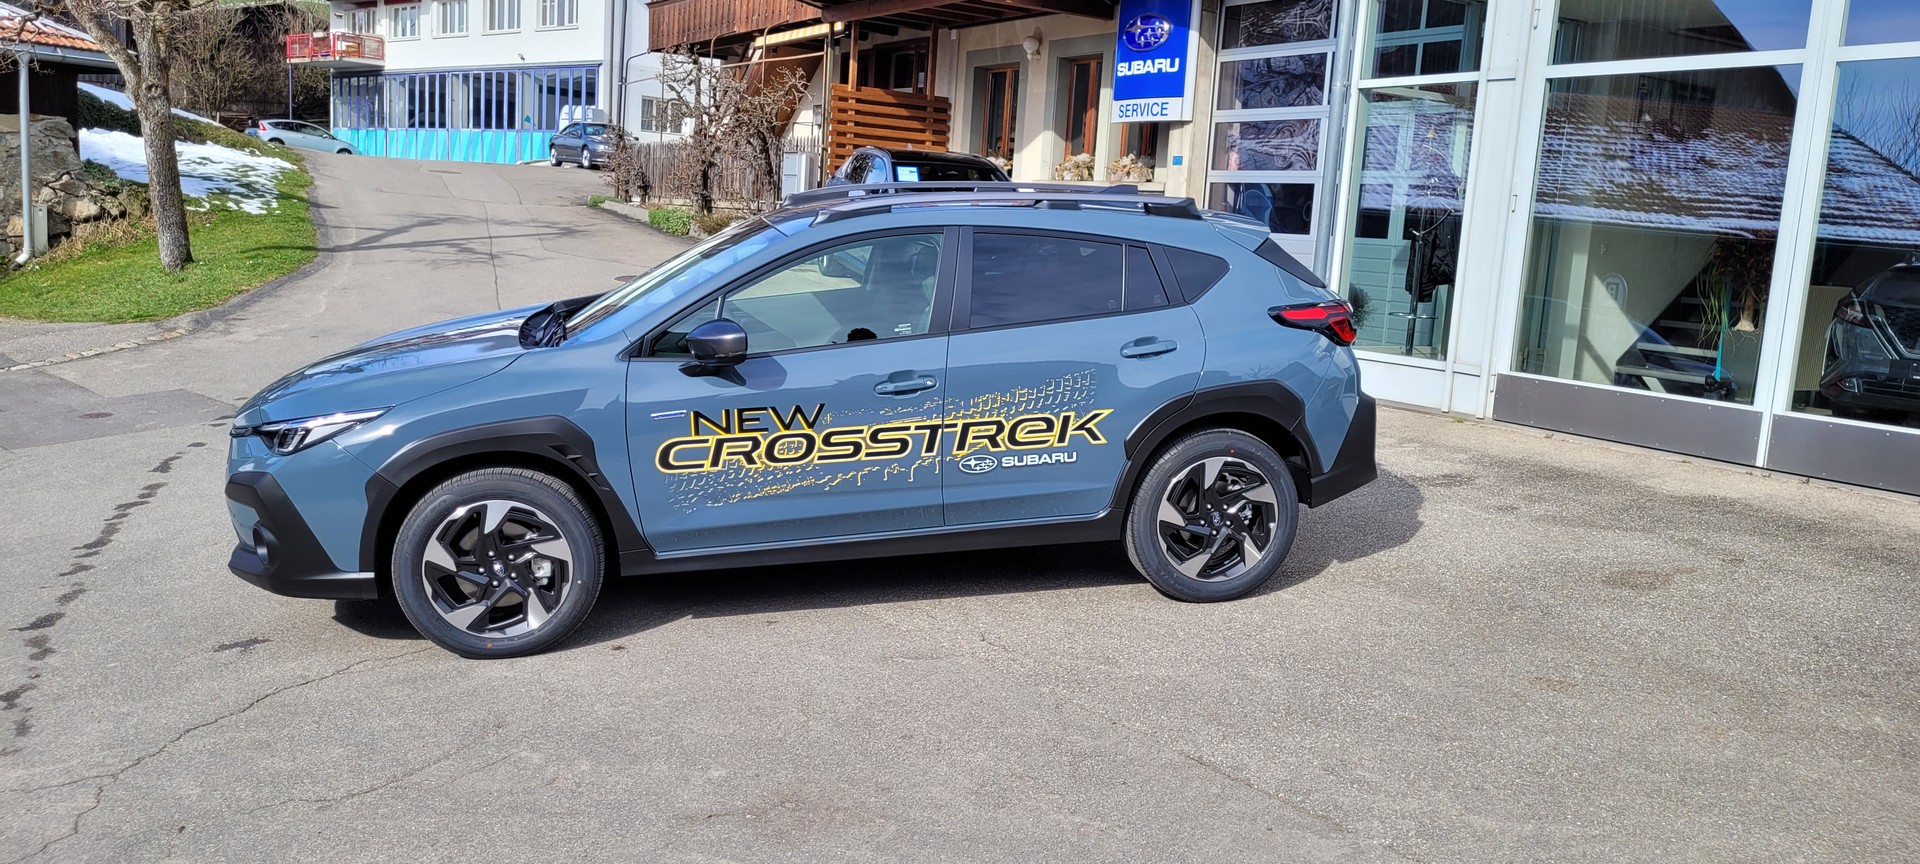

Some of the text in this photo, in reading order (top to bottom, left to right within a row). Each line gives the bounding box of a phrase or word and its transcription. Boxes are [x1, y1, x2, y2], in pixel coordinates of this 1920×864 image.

[1117, 58, 1180, 77] SUBARU
[1118, 102, 1169, 119] SERVICE
[690, 403, 826, 437] NEW
[1001, 451, 1078, 468] SUBARU
